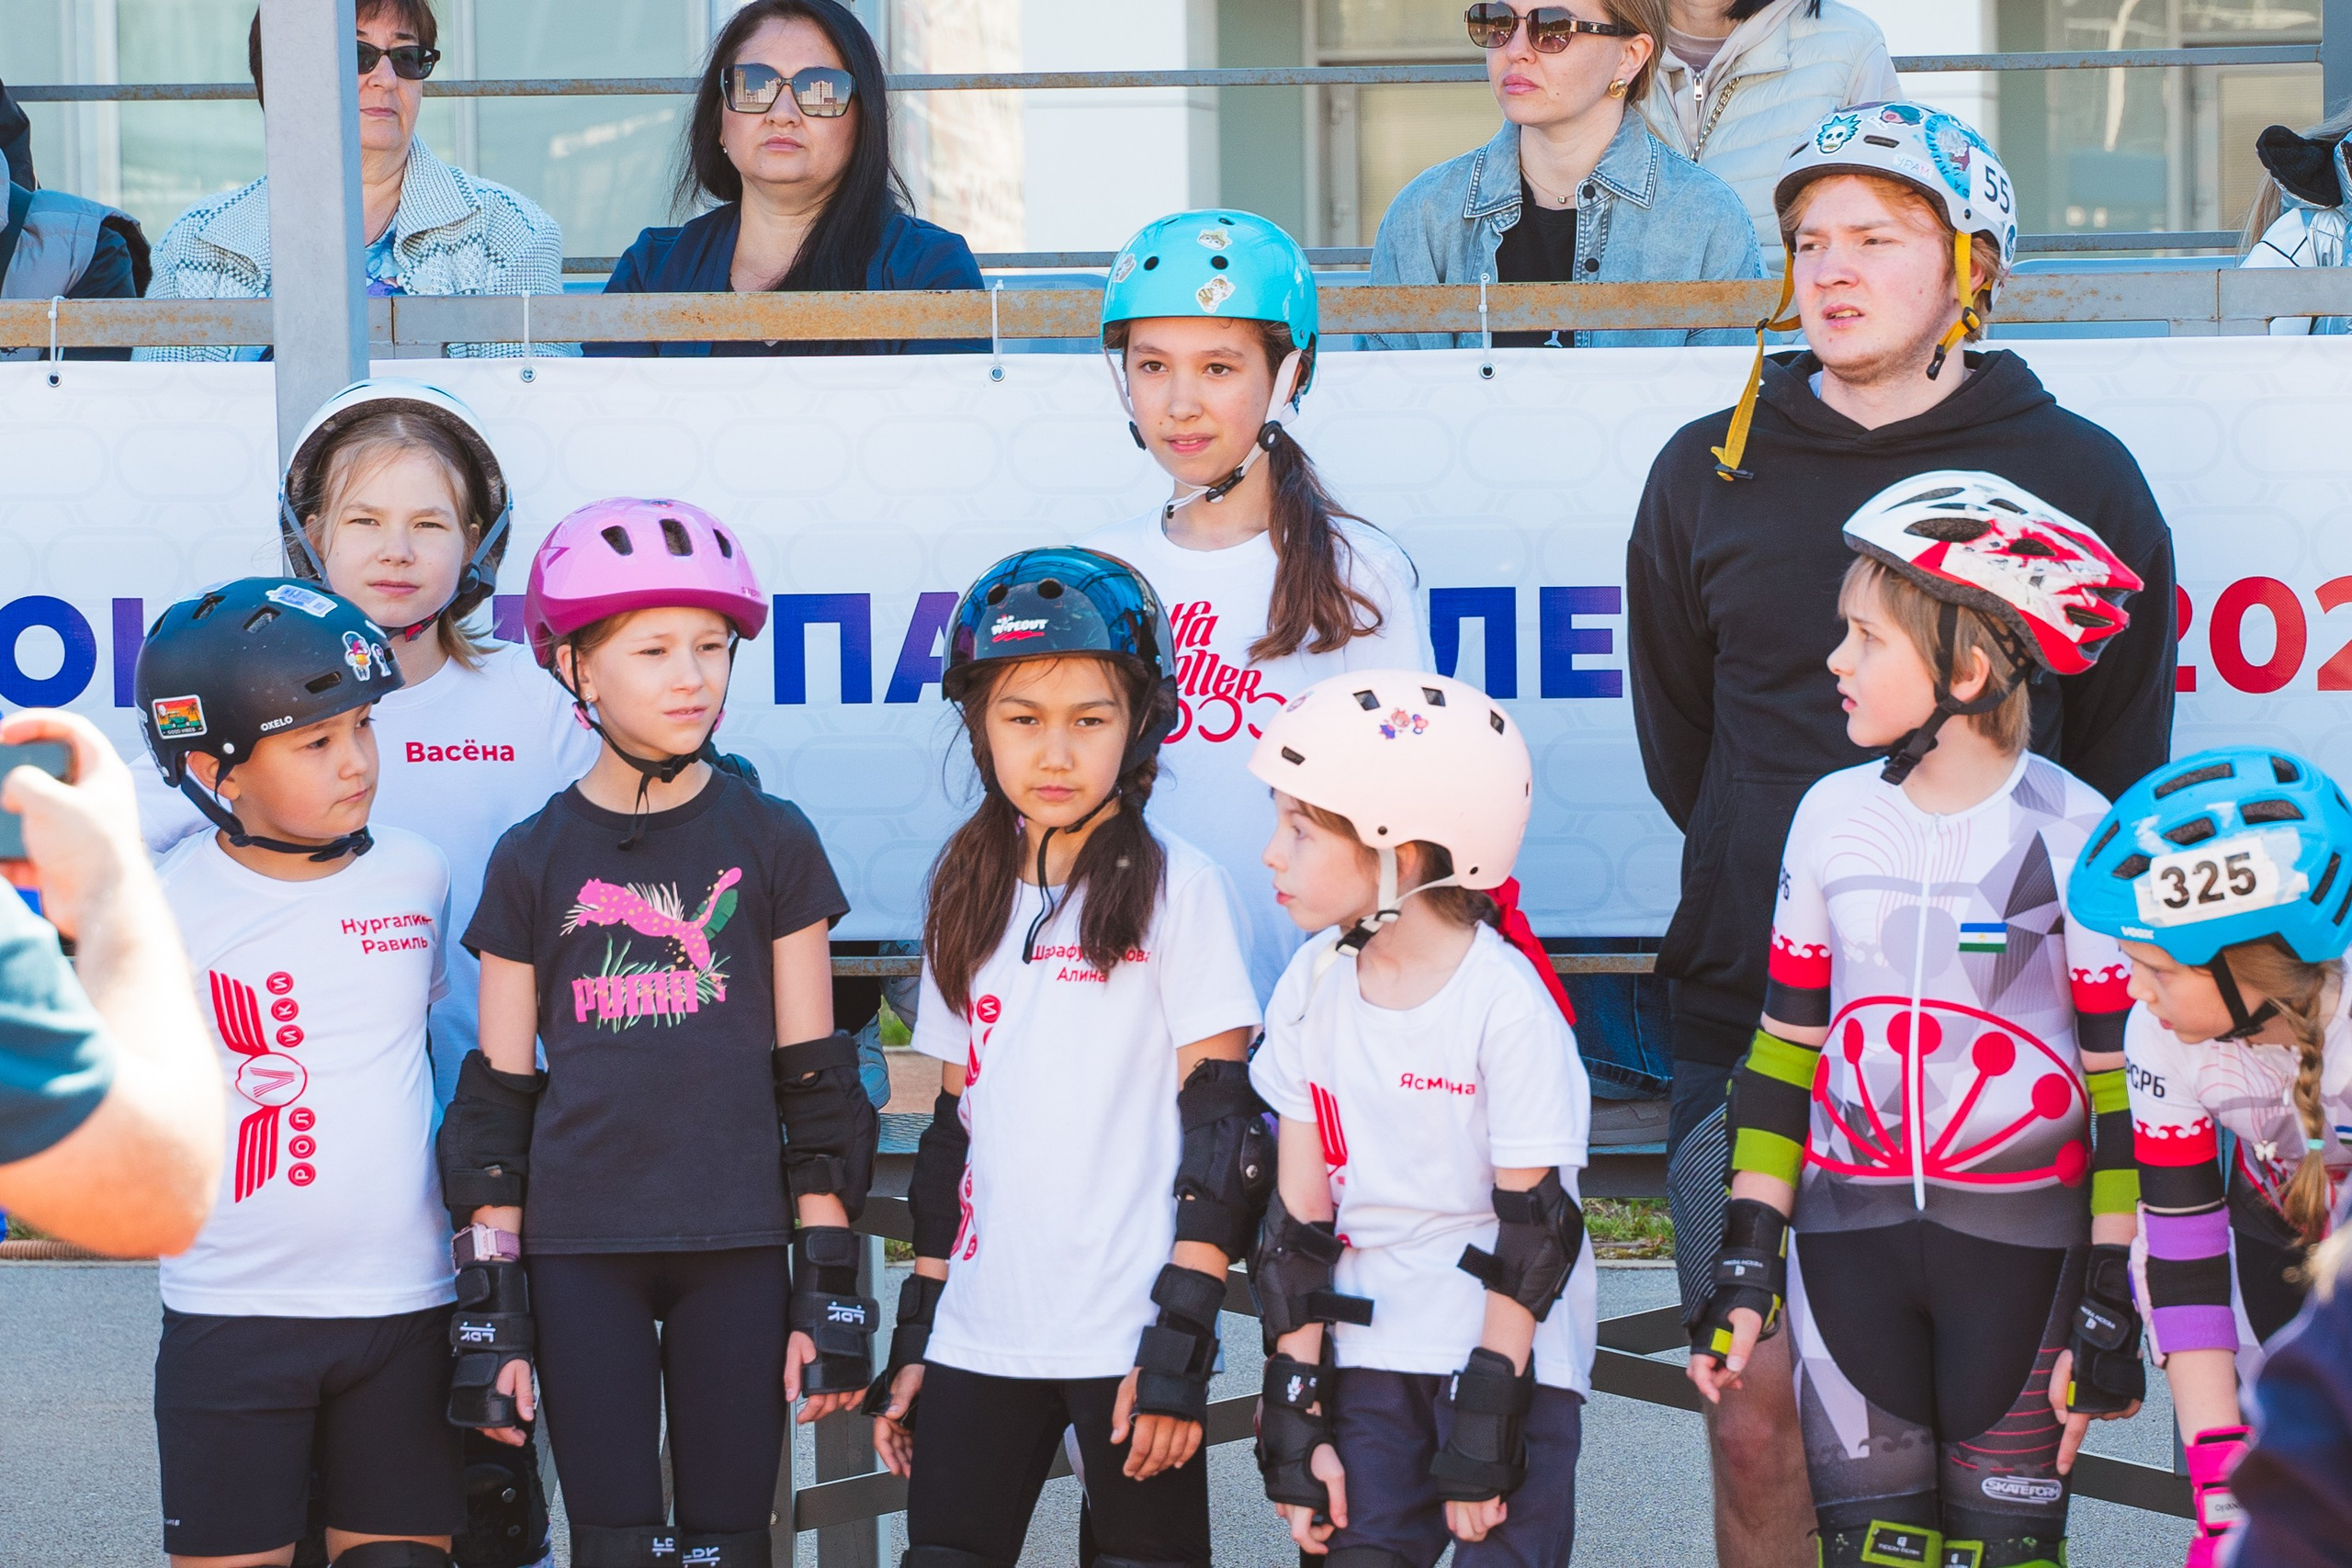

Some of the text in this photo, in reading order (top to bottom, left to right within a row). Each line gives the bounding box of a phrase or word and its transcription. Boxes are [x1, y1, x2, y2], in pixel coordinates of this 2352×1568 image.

[1984, 164, 2010, 214] 55
[260, 715, 294, 732] OXELO
[405, 739, 515, 763] Васёна
[2160, 852, 2257, 909] 325
[361, 936, 429, 955] Равиль
